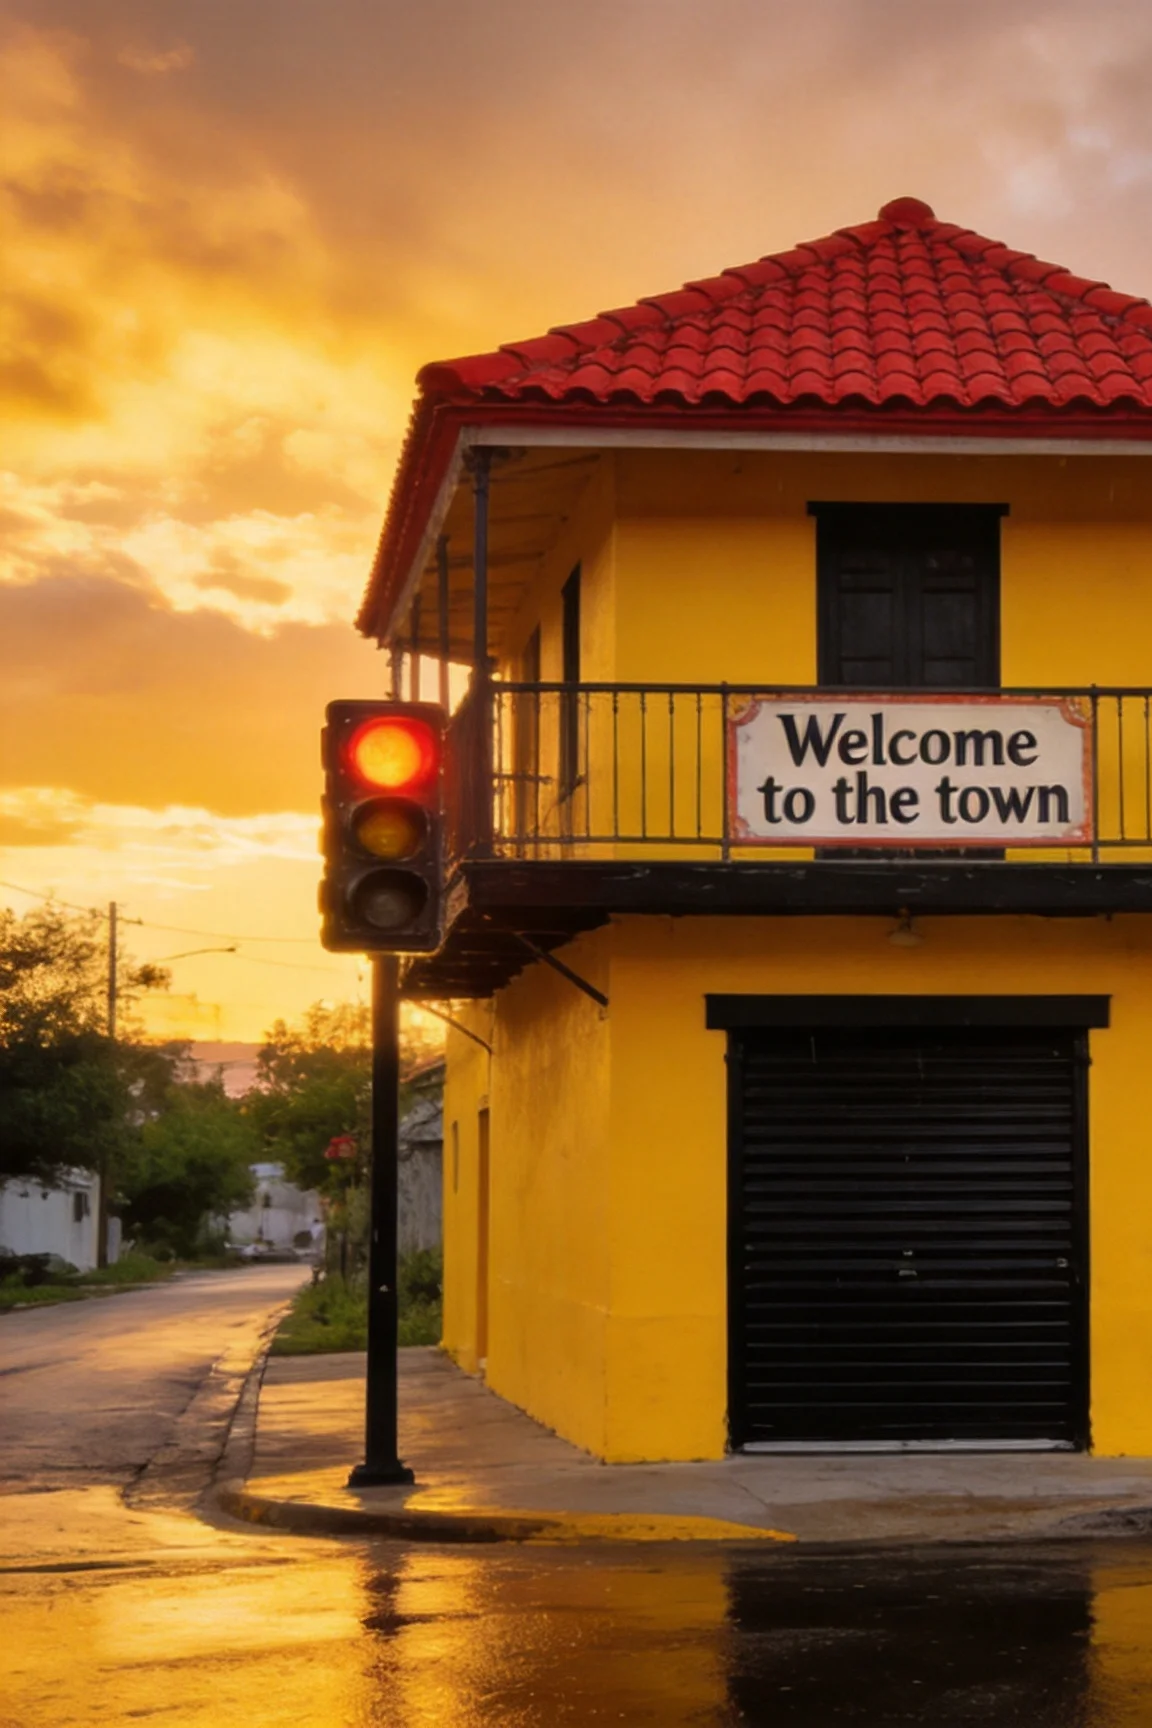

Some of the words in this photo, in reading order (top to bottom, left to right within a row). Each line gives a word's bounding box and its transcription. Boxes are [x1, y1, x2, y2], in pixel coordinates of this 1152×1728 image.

[776, 712, 1039, 767] Welcome
[757, 776, 816, 825] to
[831, 771, 920, 825] the
[935, 776, 1071, 825] town
